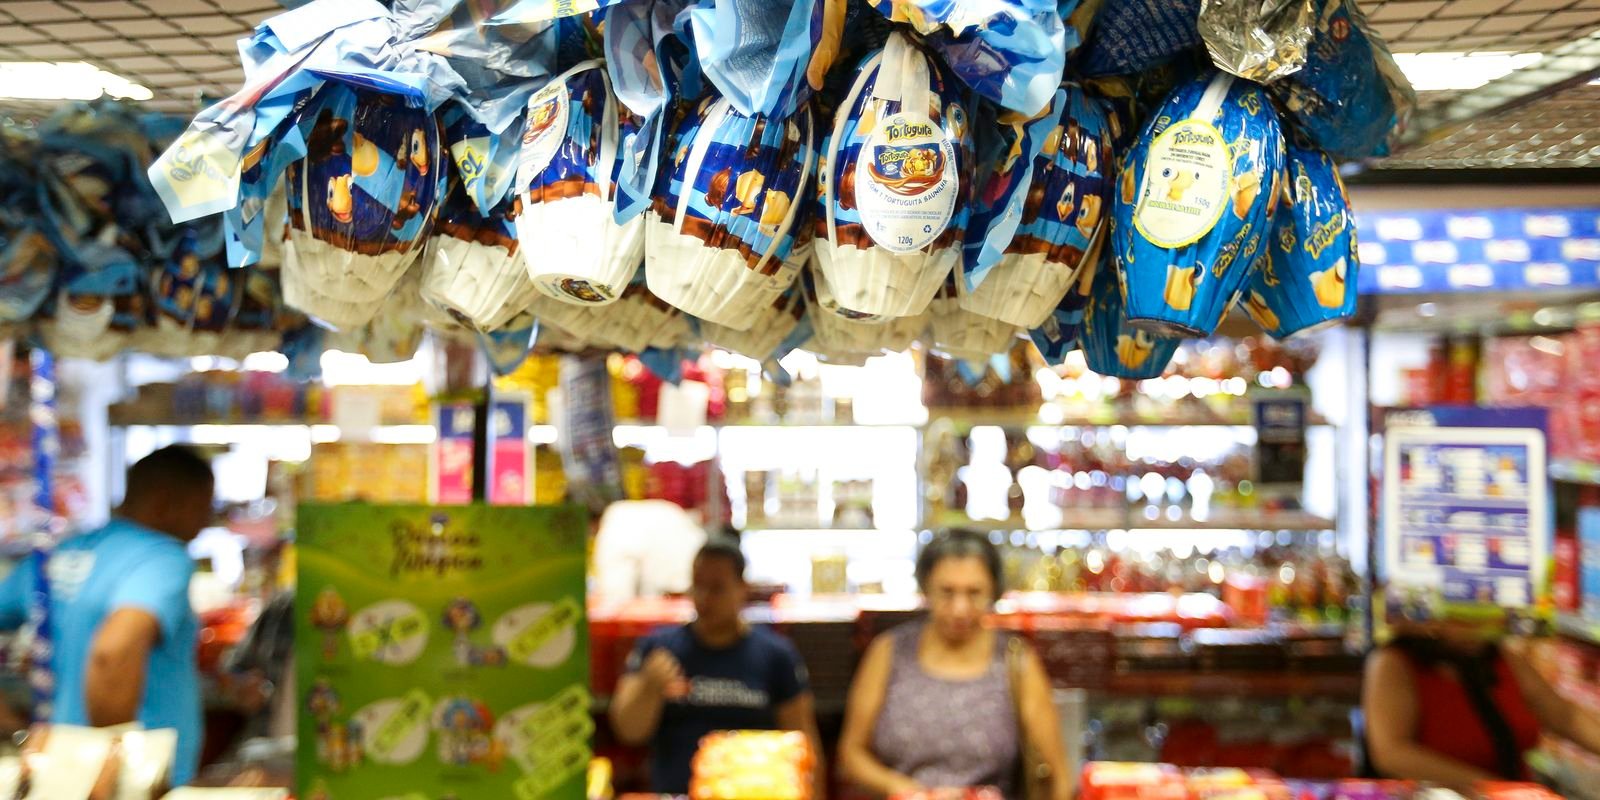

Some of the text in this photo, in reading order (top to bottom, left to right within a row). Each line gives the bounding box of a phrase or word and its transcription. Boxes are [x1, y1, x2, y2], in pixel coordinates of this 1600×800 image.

[886, 123, 932, 141] Tortuguita
[884, 195, 923, 206] TORTUGUITA
[923, 179, 948, 203] BAUNILHA
[897, 235, 913, 246] 120g
